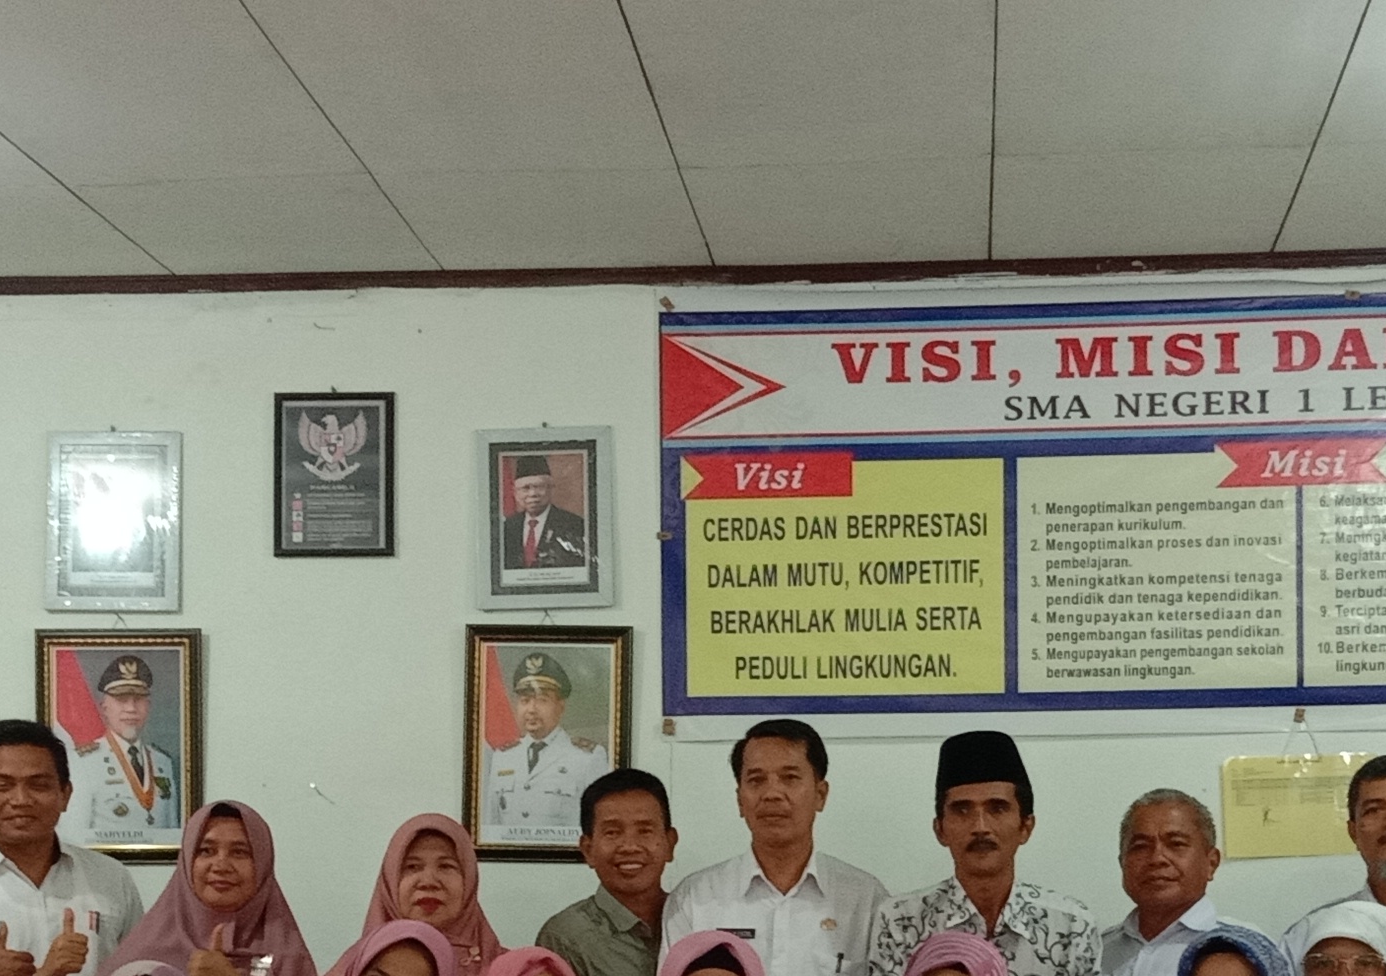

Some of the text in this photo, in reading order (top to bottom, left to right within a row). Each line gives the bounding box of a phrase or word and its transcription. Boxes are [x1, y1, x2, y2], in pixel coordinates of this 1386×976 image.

[831, 340, 1022, 388] VISI,
[1055, 332, 1240, 379] MISI
[1004, 394, 1091, 421] SMA
[1114, 390, 1269, 418] NEGERI
[1298, 388, 1315, 413] 1
[1260, 449, 1347, 478] Misi
[735, 463, 805, 490] Visi
[1046, 499, 1284, 517] Mengoptimalkan pengembangan dan
[703, 513, 987, 541] CERDAS DAN BERPRESTASI
[1046, 519, 1186, 535] penerapan kurikulum.
[1046, 535, 1282, 552] Mengoptimalkan proses dan inovasi
[1046, 558, 1132, 572] pembelajaran.
[708, 560, 983, 590] DALAM MUTU, KOMPETITIF,
[1046, 572, 1282, 589] Meningkatkan kompetensi tenaga
[1046, 590, 1282, 608] pendidik dan tenaga kependidikan.
[711, 607, 982, 634] BERAKHLAK MULIA SERTA
[1046, 608, 1282, 625] Mengupayakan ketersediaan dan
[1046, 627, 1284, 644] pengembangan fasilitas pendidikan.
[1046, 648, 1136, 662] Mengupayakan
[1140, 646, 1233, 660] pengembangan
[735, 654, 957, 679] PEDULI LINGKUNGAN.
[1046, 665, 1195, 679] berwawasan lingkungan.
